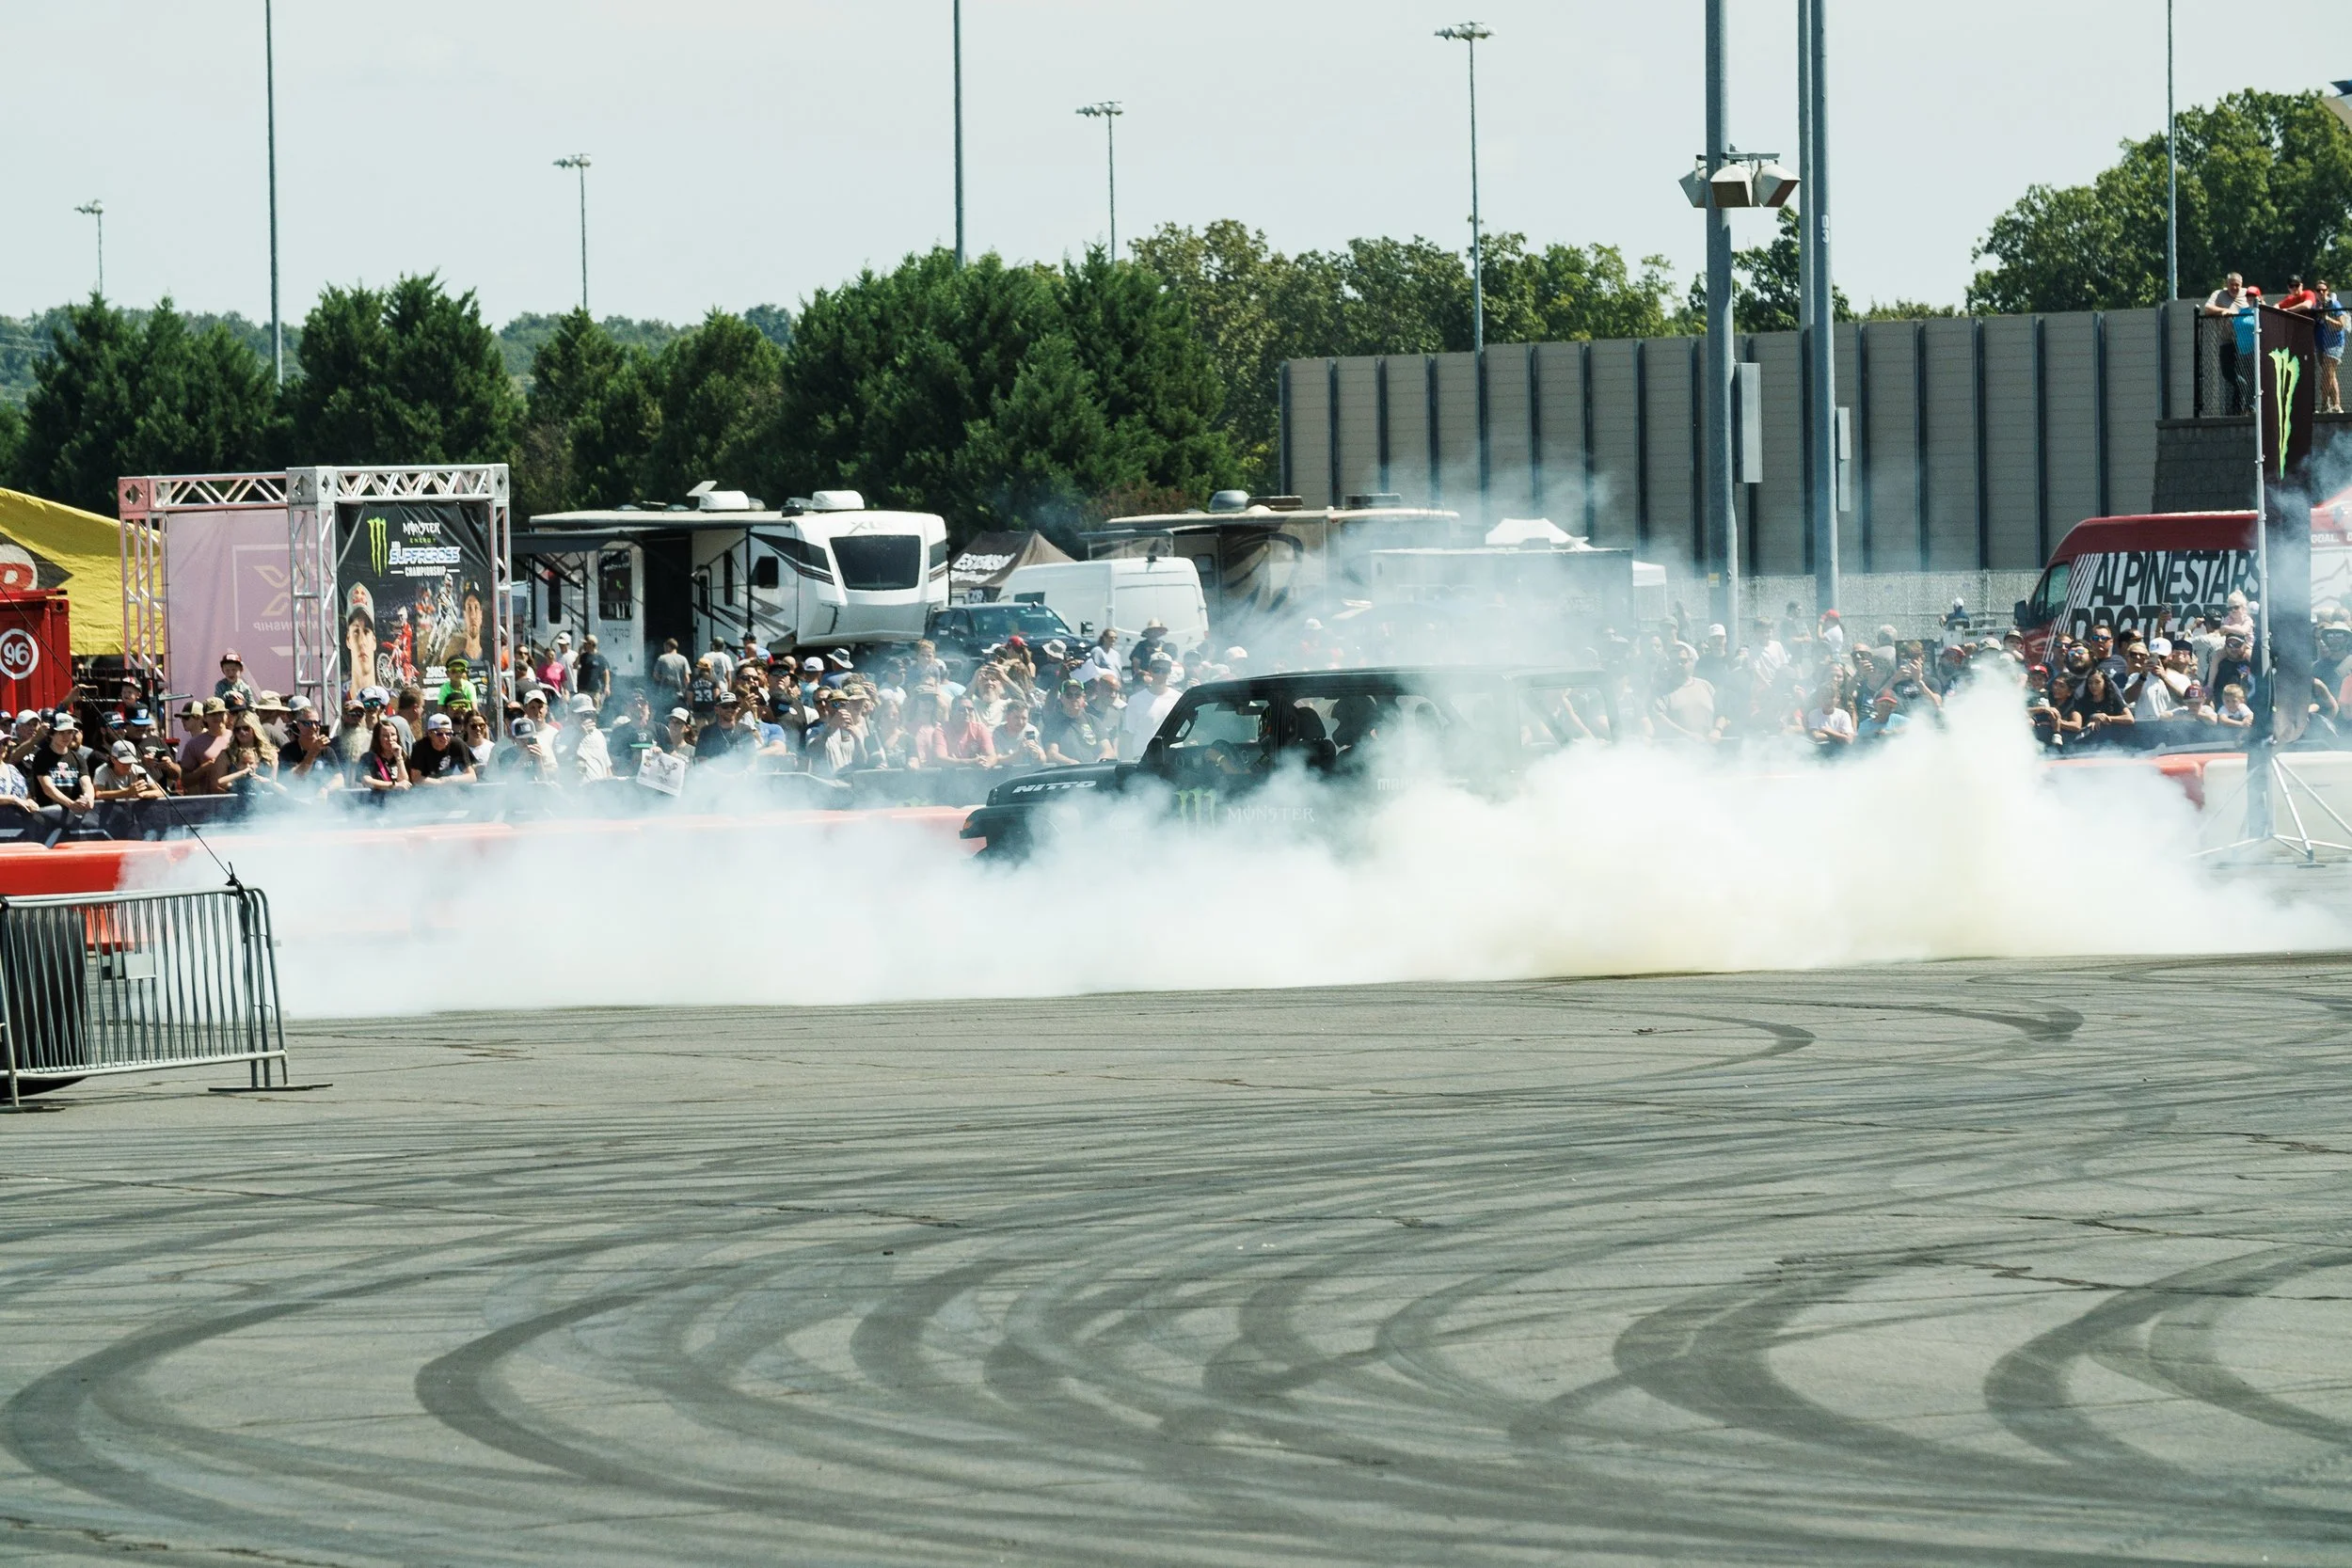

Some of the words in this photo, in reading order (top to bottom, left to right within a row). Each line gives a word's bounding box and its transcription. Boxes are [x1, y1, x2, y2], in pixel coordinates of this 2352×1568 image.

[2090, 550, 2261, 604] ALPINESTARS
[4, 641, 30, 667] 96
[694, 689, 713, 702] 23
[1011, 780, 1097, 794] NITTO
[1227, 805, 1316, 823] MONSTER
